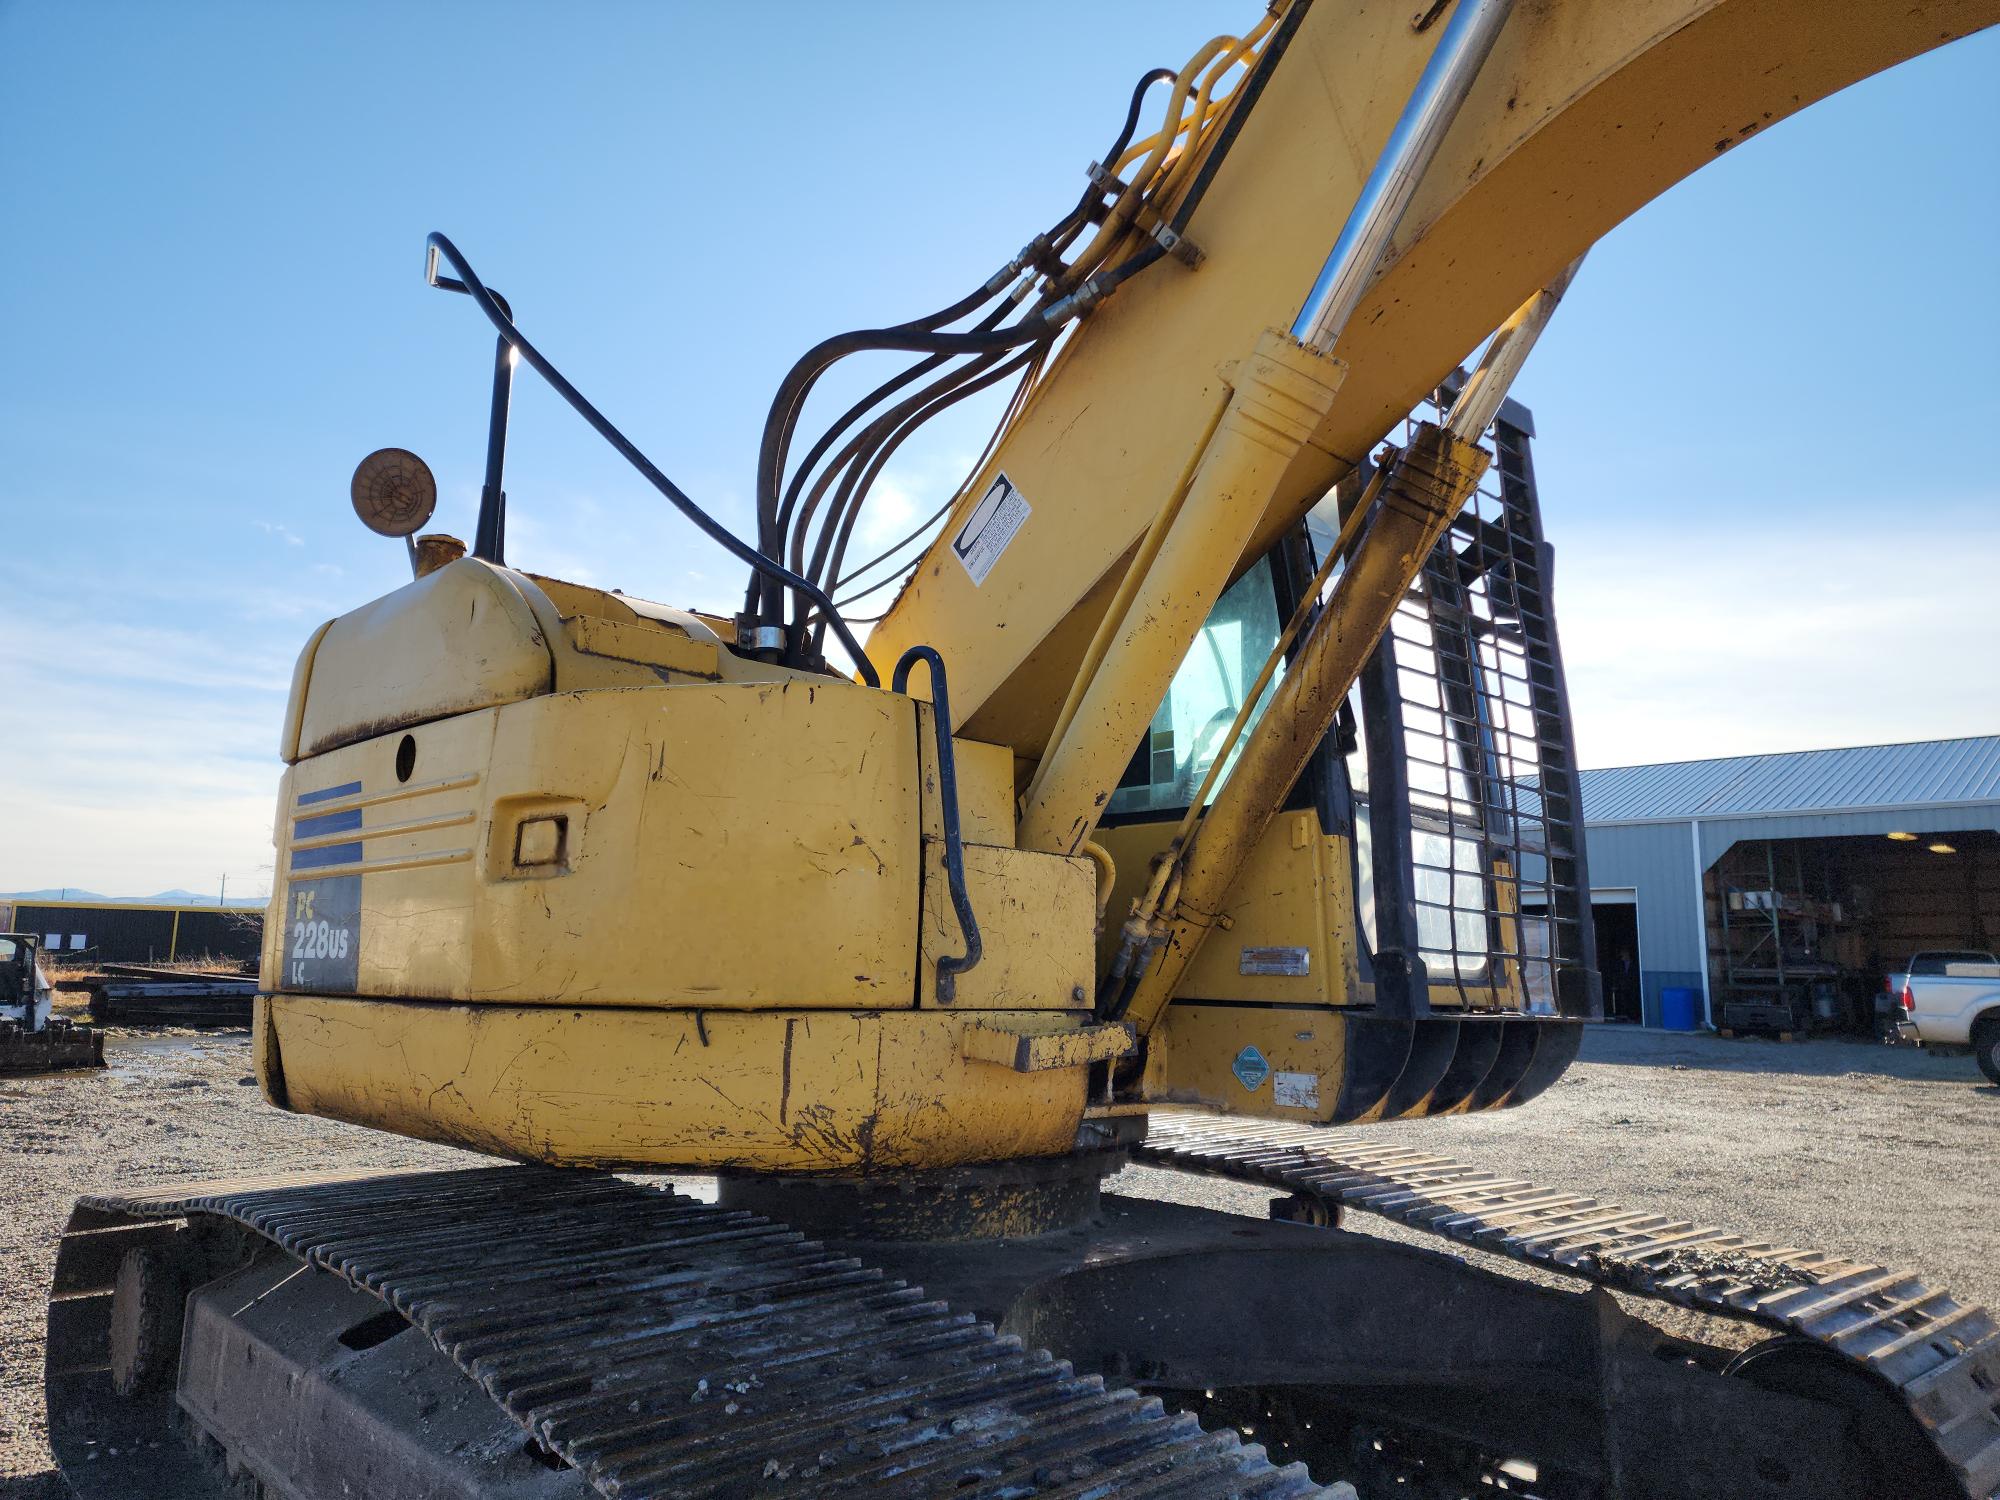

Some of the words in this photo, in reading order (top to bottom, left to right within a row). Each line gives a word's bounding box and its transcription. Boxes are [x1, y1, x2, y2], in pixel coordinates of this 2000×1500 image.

[296, 890, 315, 919] PC
[292, 920, 348, 959] 228US
[292, 961, 305, 985] LC
